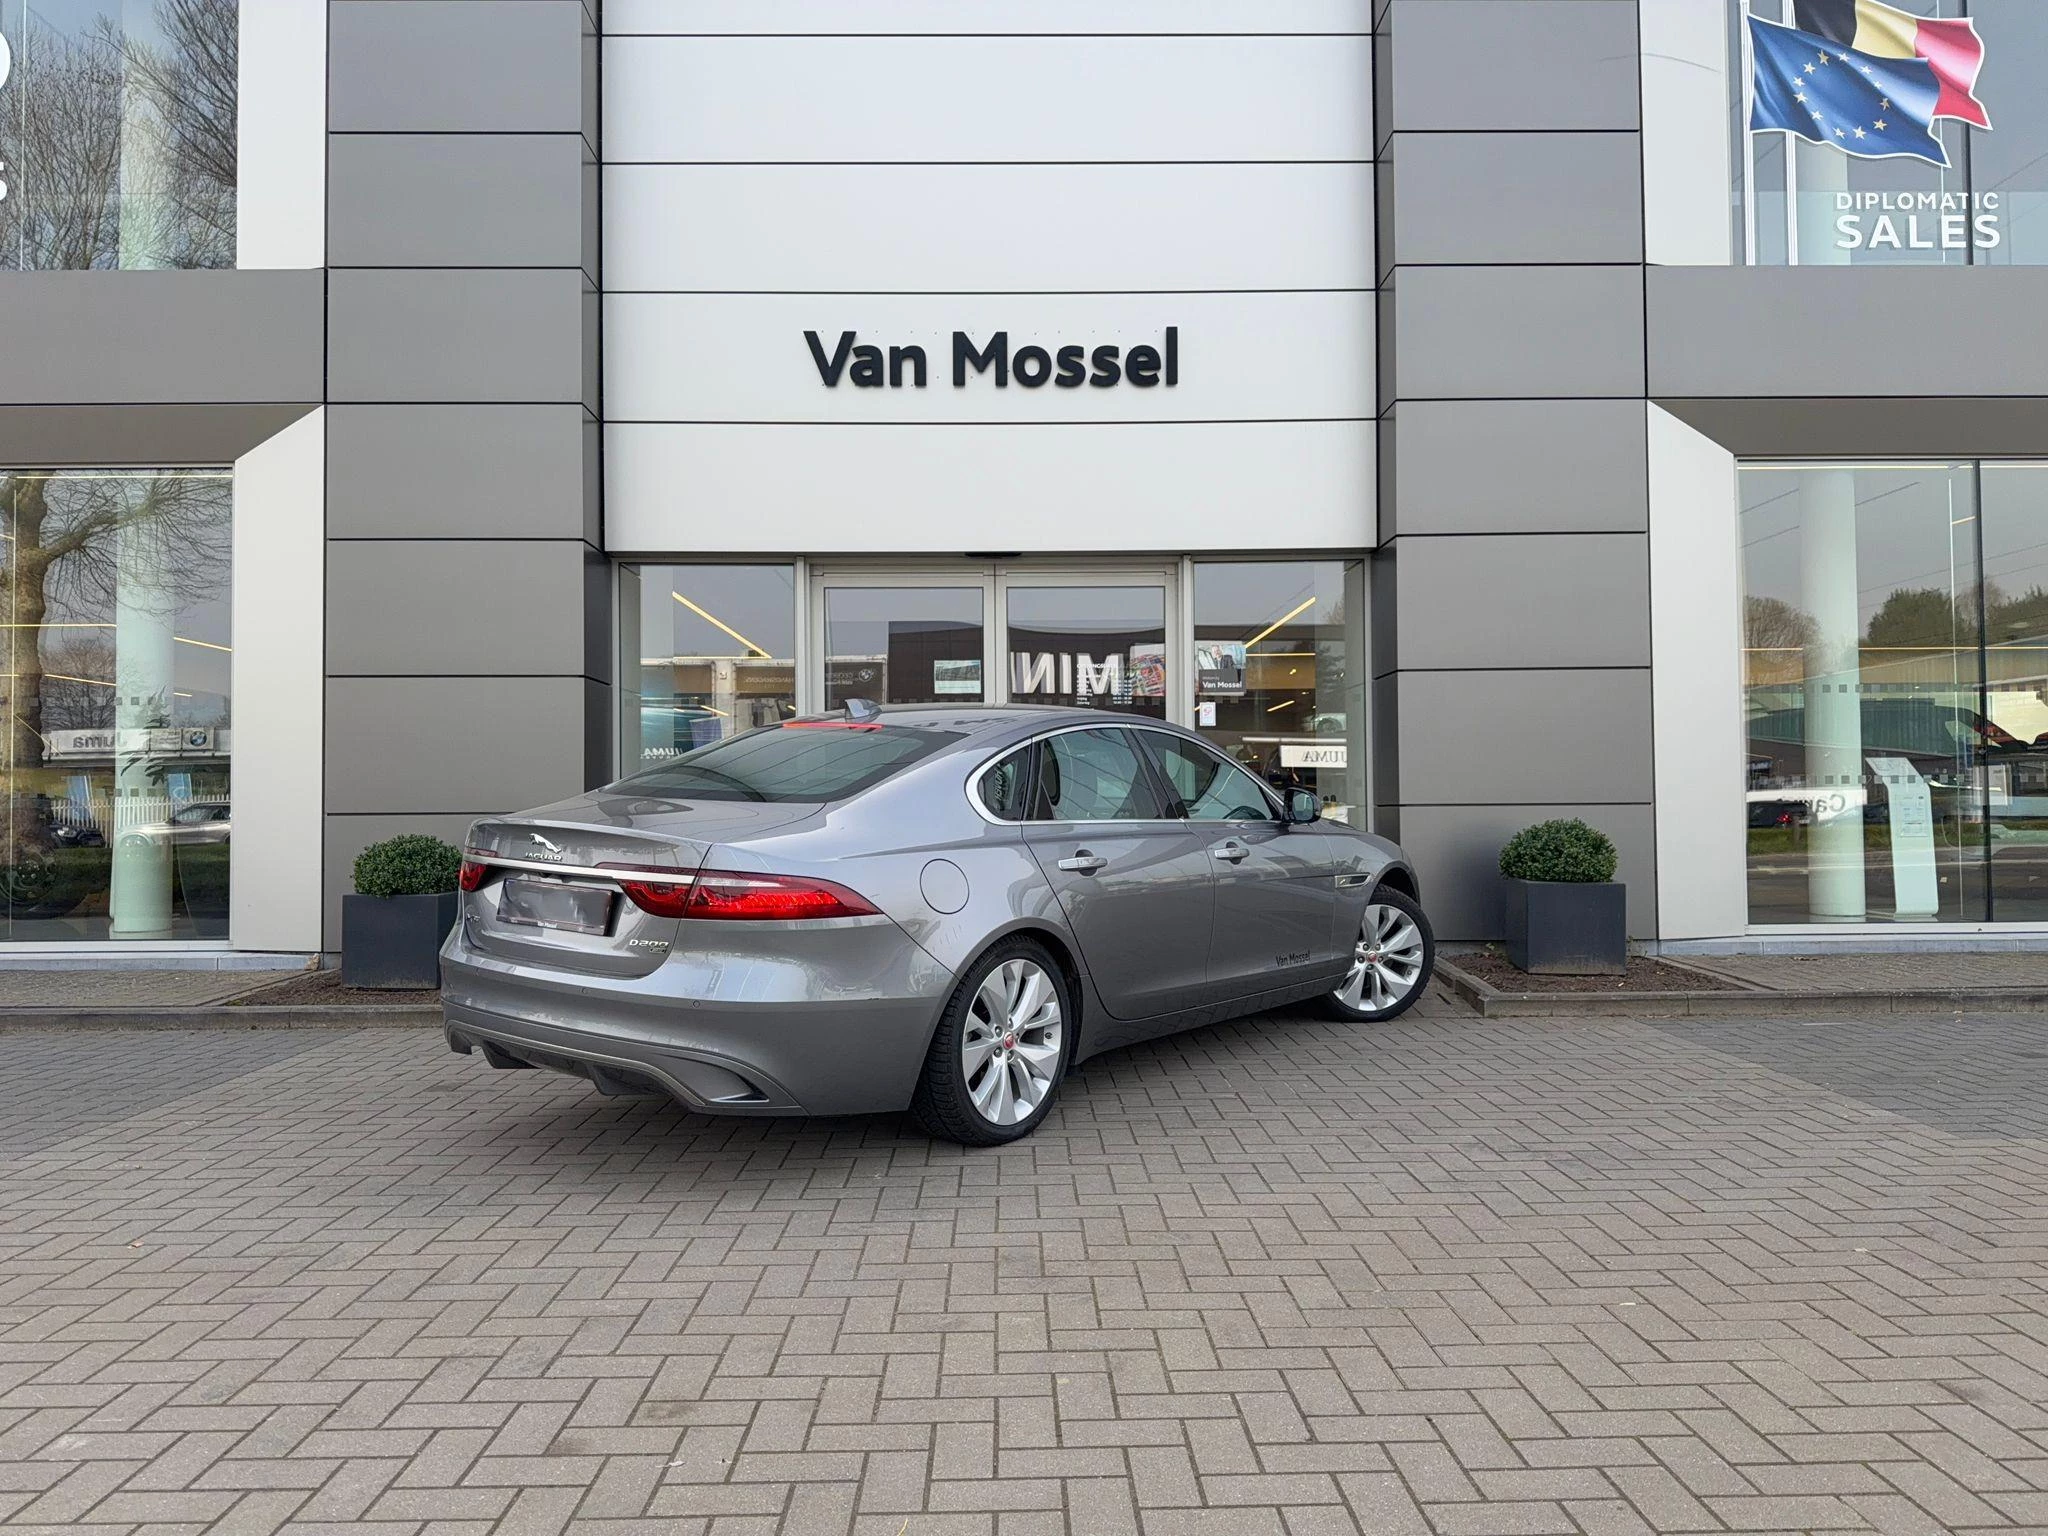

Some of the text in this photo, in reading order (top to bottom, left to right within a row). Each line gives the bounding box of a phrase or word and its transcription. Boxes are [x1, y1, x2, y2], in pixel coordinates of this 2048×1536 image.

[1836, 191, 1999, 210] DIPLOMATIC
[1836, 214, 2001, 249] SALES
[802, 326, 1179, 388] Van Mossel
[1202, 680, 1242, 689] Van Mossel
[629, 939, 669, 948] D200
